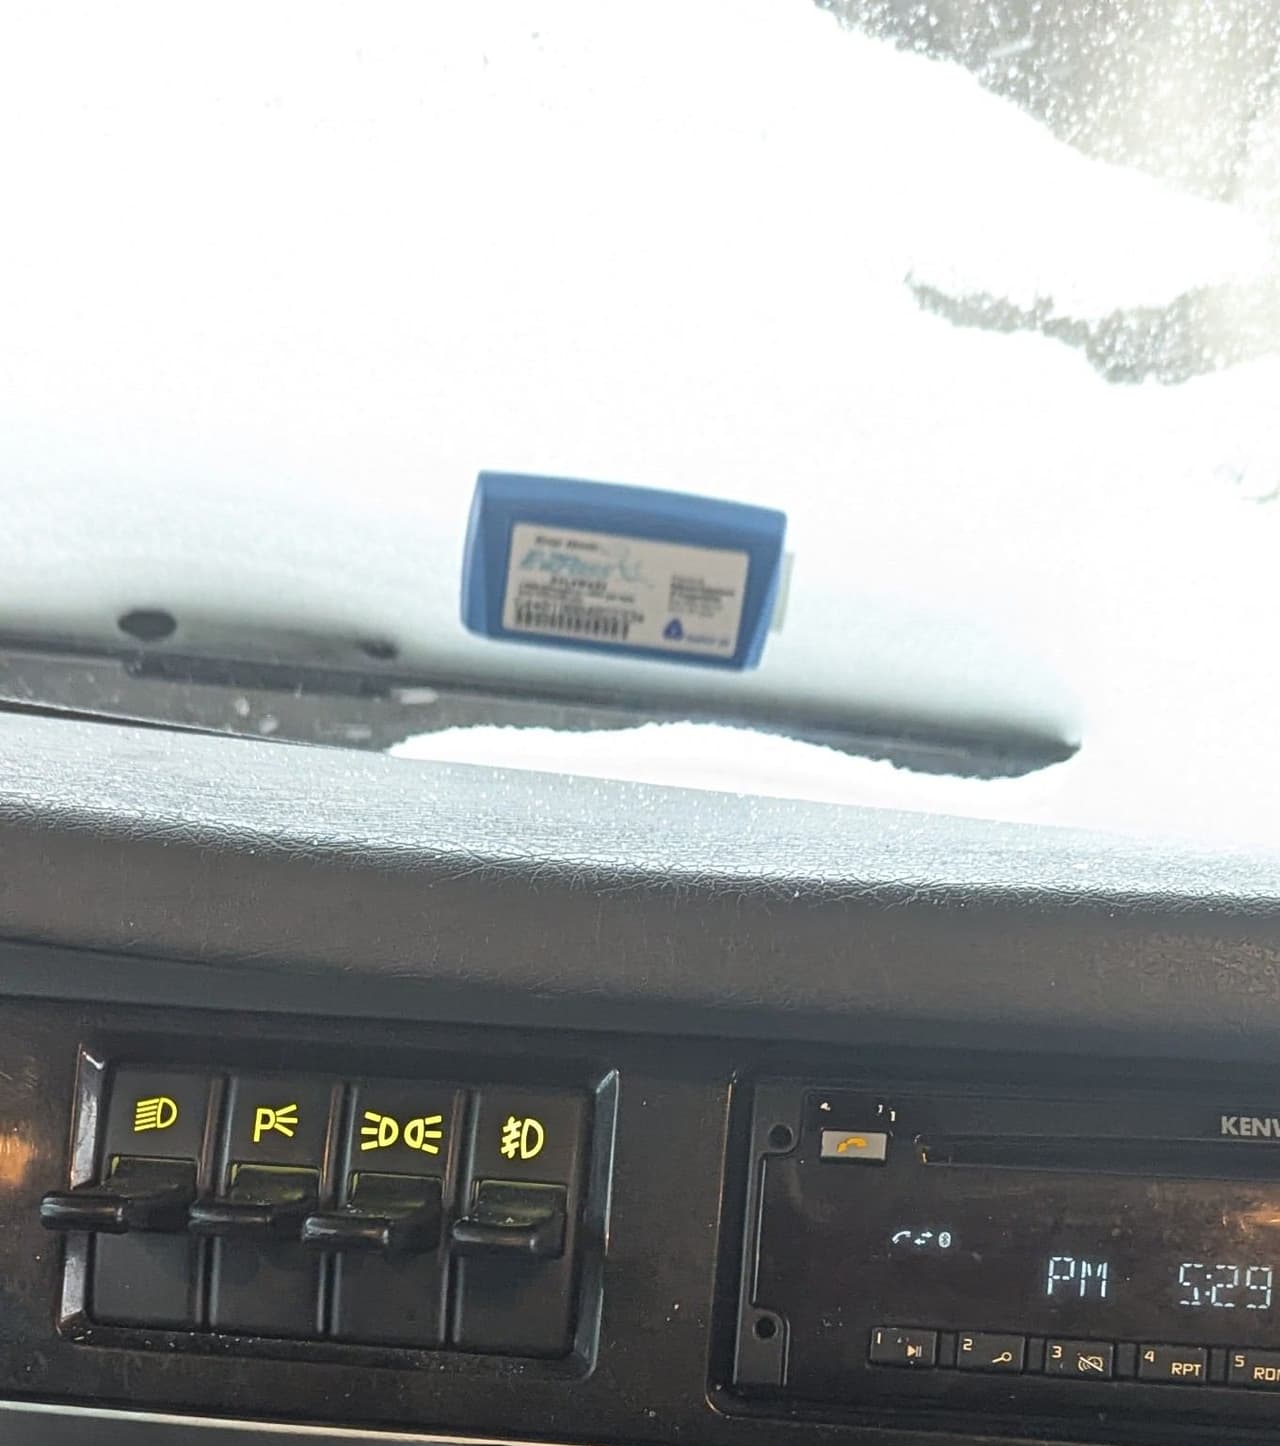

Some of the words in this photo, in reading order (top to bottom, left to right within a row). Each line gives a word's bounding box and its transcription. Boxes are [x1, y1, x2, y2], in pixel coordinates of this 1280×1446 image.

[1047, 1256, 1109, 1298] PM
[1178, 1262, 1273, 1309] 5:29
[962, 1338, 973, 1351] 2
[1051, 1345, 1062, 1359] 3
[1144, 1350, 1155, 1363] 4
[1171, 1362, 1202, 1378] RPT
[1234, 1355, 1245, 1369] 5
